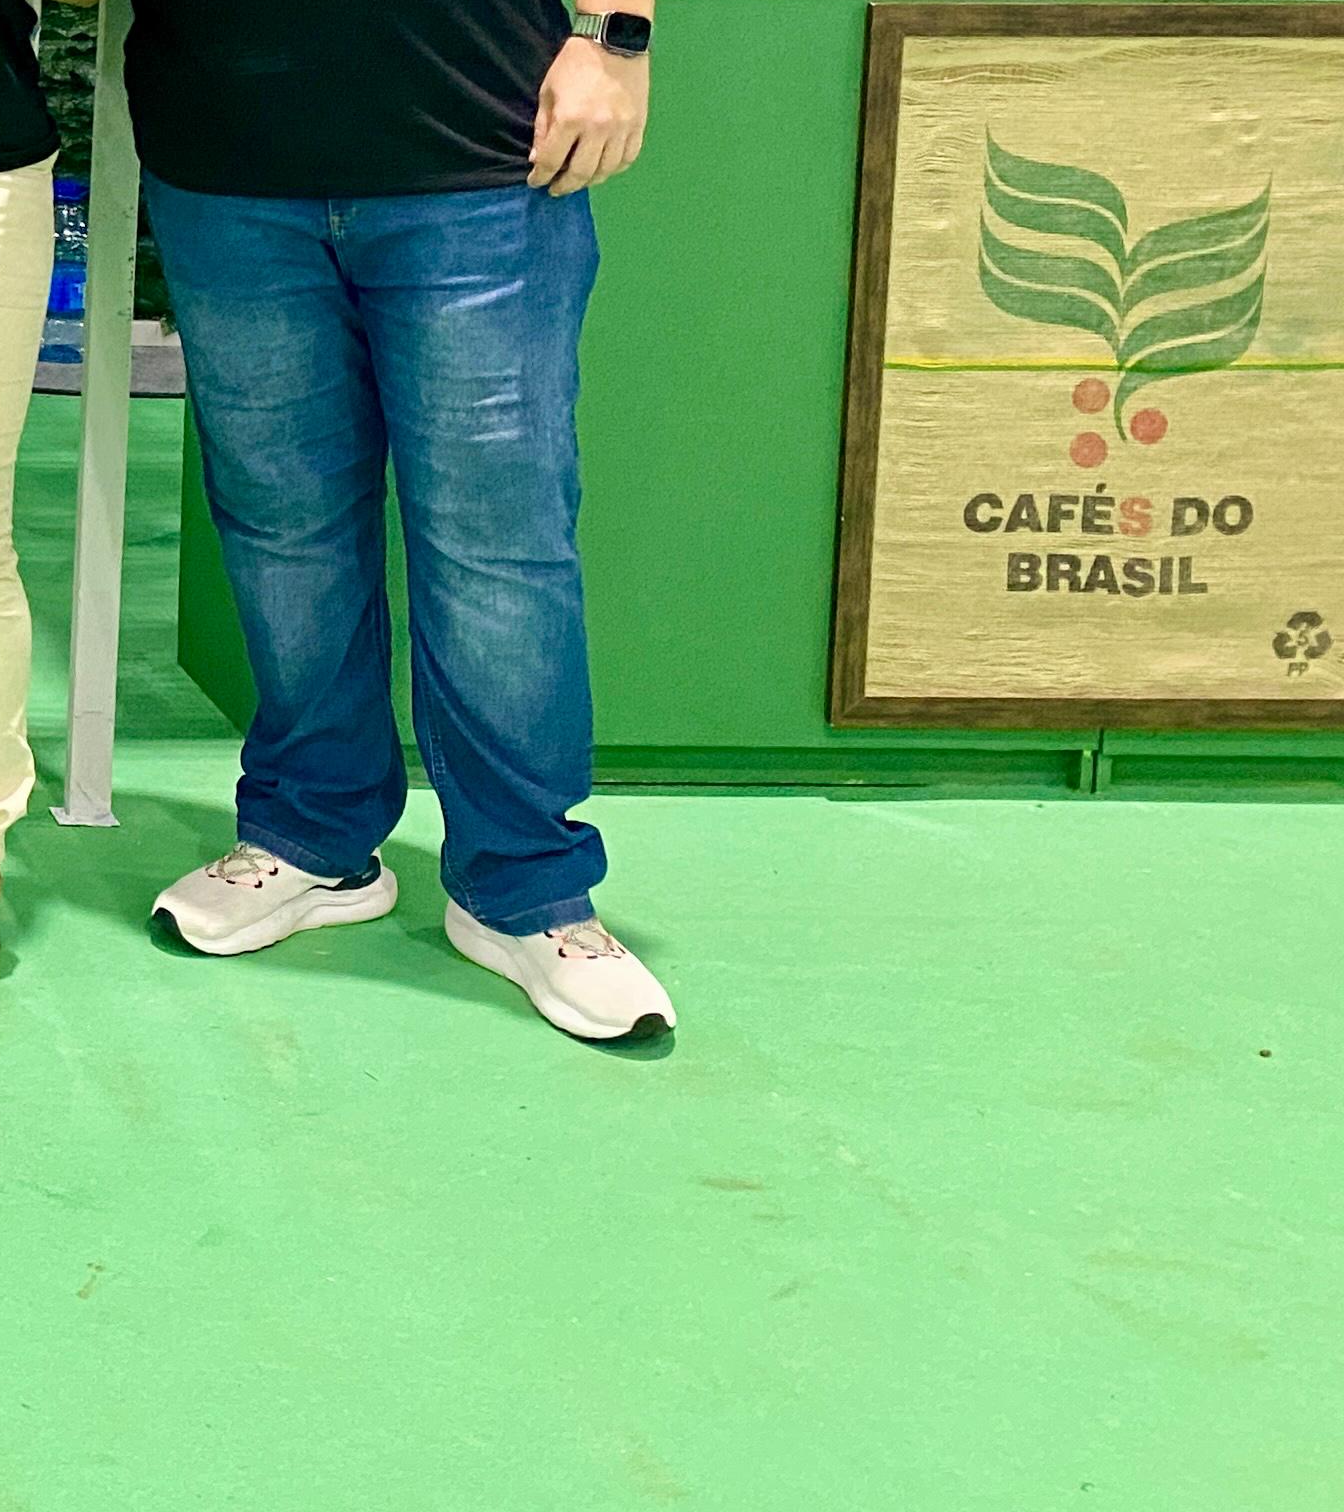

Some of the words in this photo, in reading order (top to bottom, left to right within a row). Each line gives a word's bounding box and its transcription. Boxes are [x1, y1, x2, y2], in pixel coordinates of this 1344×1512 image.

[963, 482, 1154, 538] CAFÉS
[1170, 494, 1255, 538] DO
[1006, 552, 1209, 598] BRASIL
